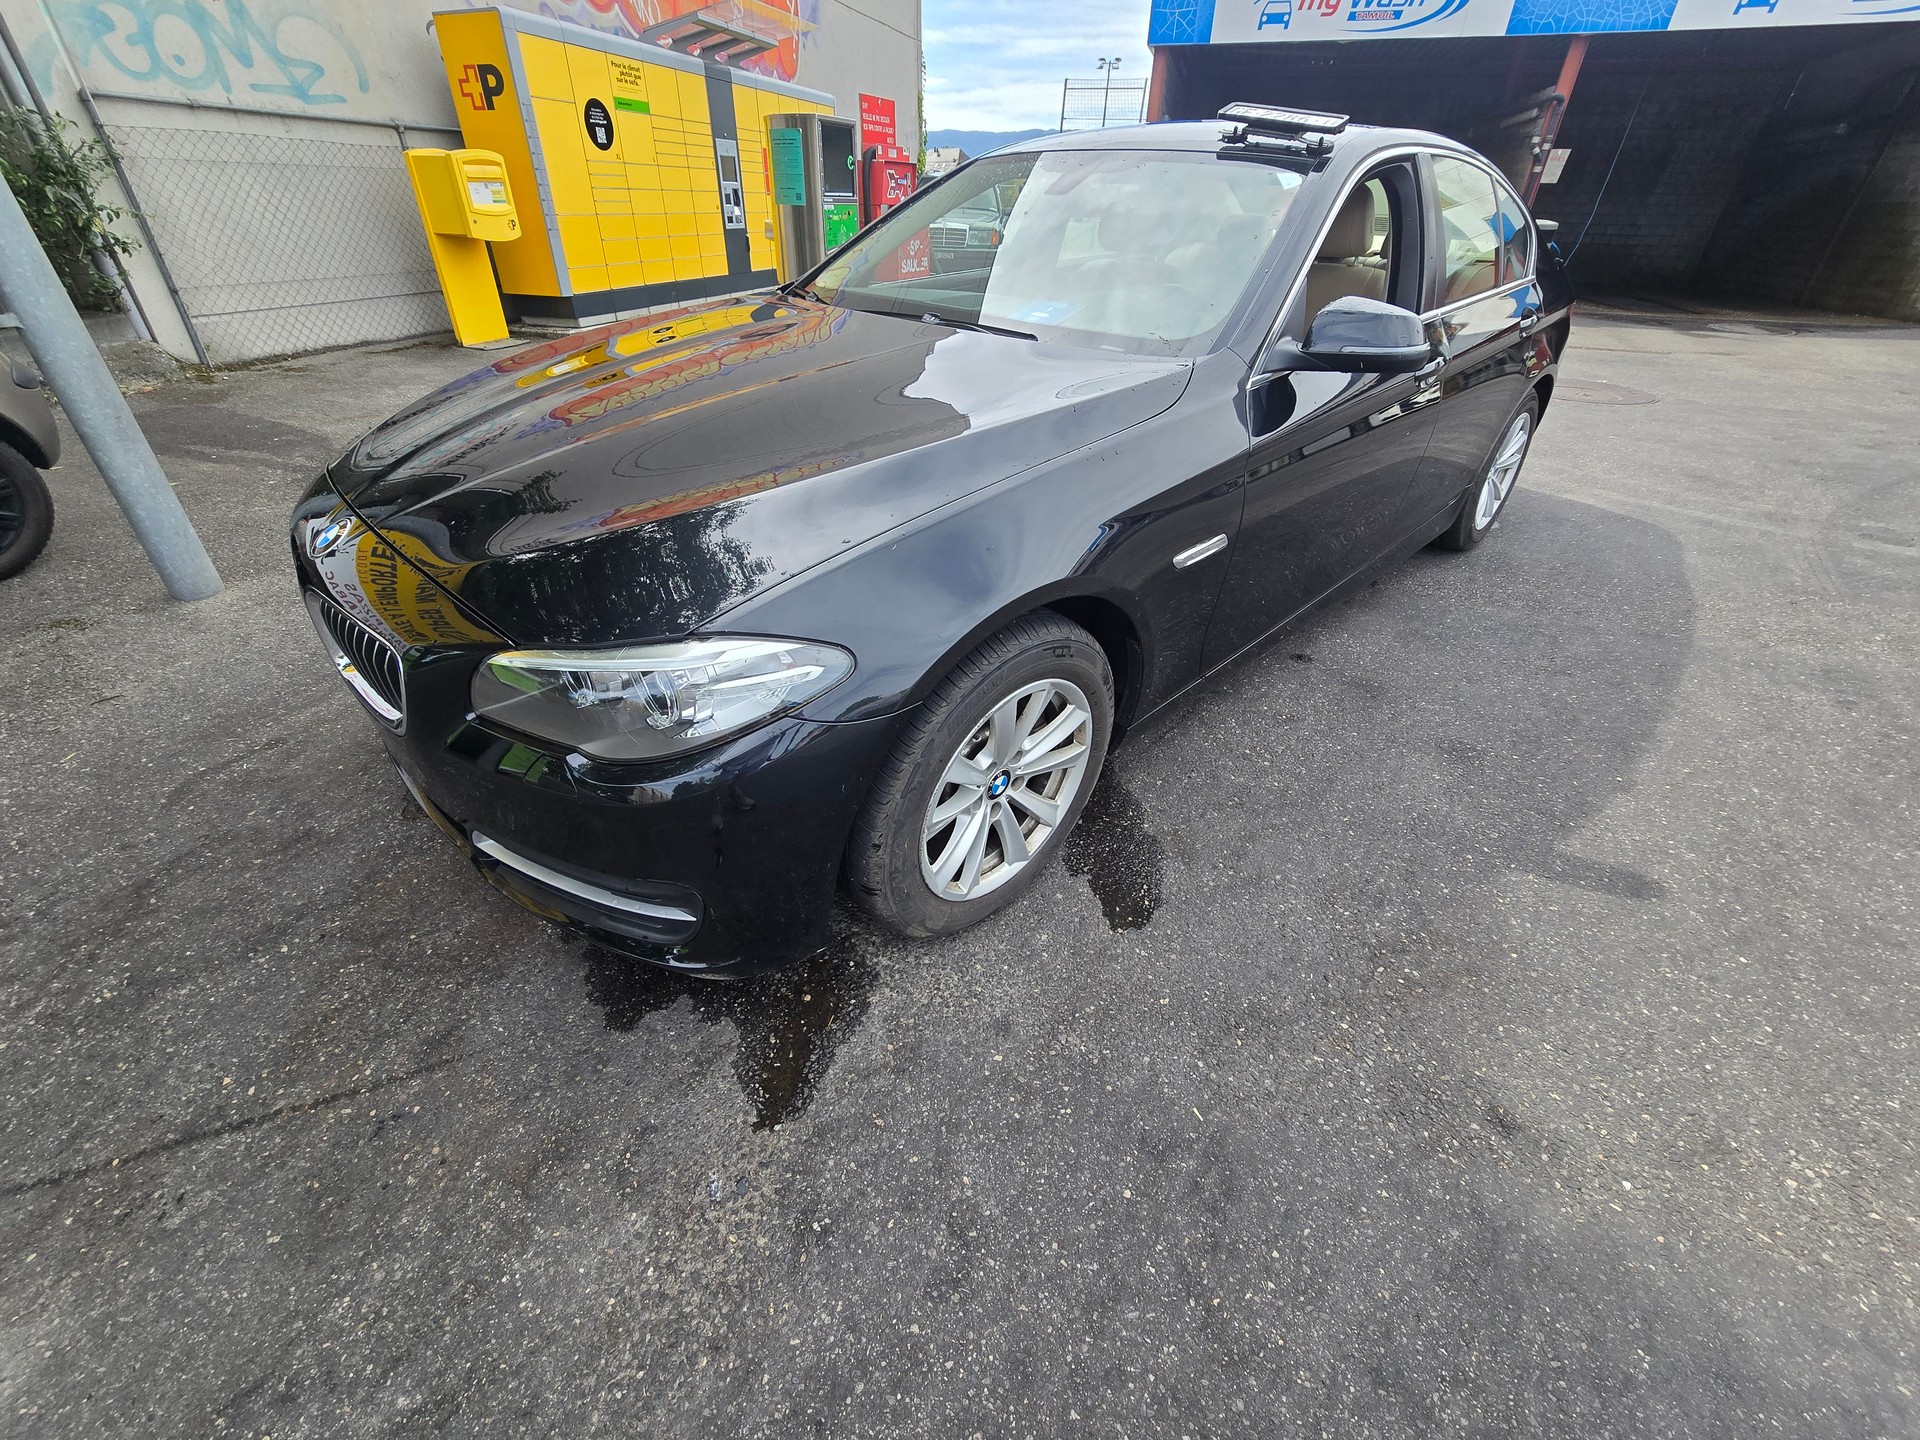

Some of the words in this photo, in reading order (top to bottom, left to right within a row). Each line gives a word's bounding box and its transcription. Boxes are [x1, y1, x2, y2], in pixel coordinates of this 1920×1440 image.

[1356, 10, 1395, 20] TAMOIL
[611, 60, 622, 69] Pour
[477, 64, 505, 111] P
